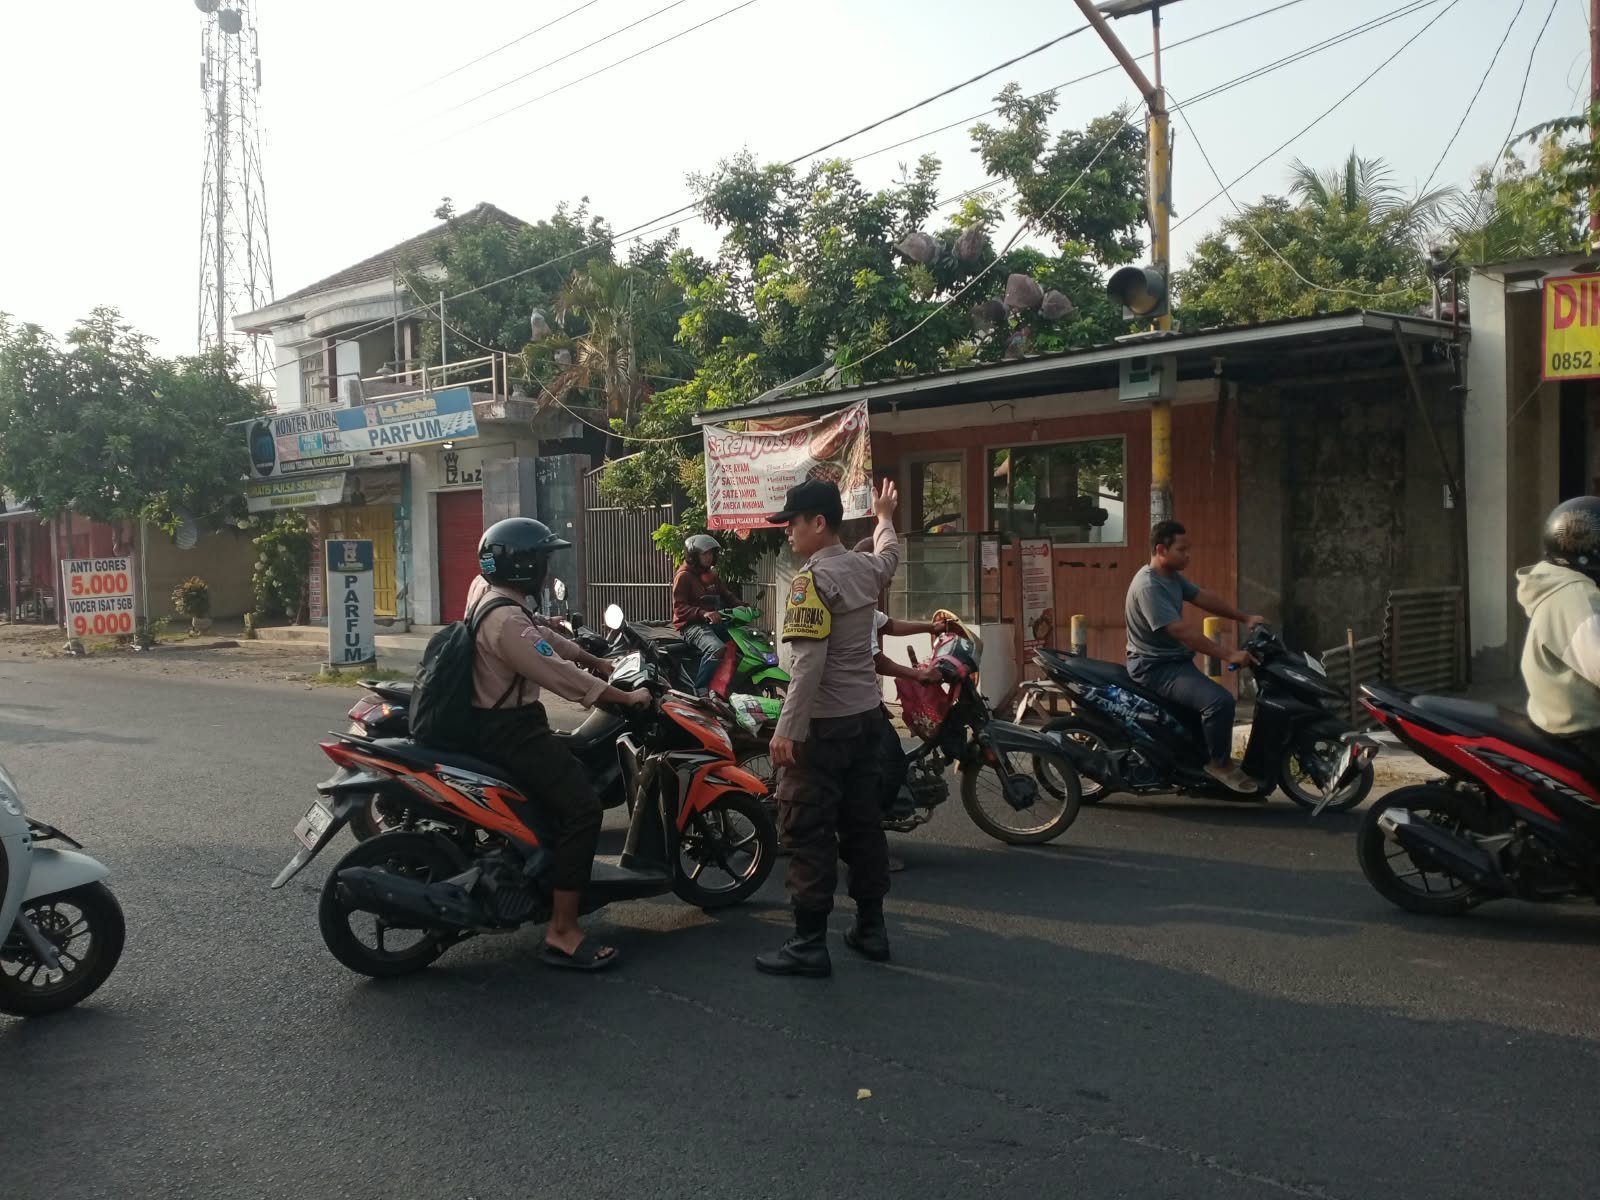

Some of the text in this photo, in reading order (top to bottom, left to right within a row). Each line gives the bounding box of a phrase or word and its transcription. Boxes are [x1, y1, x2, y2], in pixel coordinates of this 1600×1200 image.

[1552, 350, 1593, 371] 0852
[275, 416, 308, 435] KONTER
[367, 418, 443, 447] PARFUM
[733, 463, 750, 473] AYAM
[461, 471, 474, 483] La
[722, 489, 739, 499] SATE
[722, 501, 741, 510] ANEKA
[70, 559, 127, 573] ANTI GORES
[71, 573, 128, 596] 5.000
[69, 598, 133, 614] VOCER ISAT 5GB
[74, 612, 132, 636] 9.000
[343, 575, 362, 662] PARFUM
